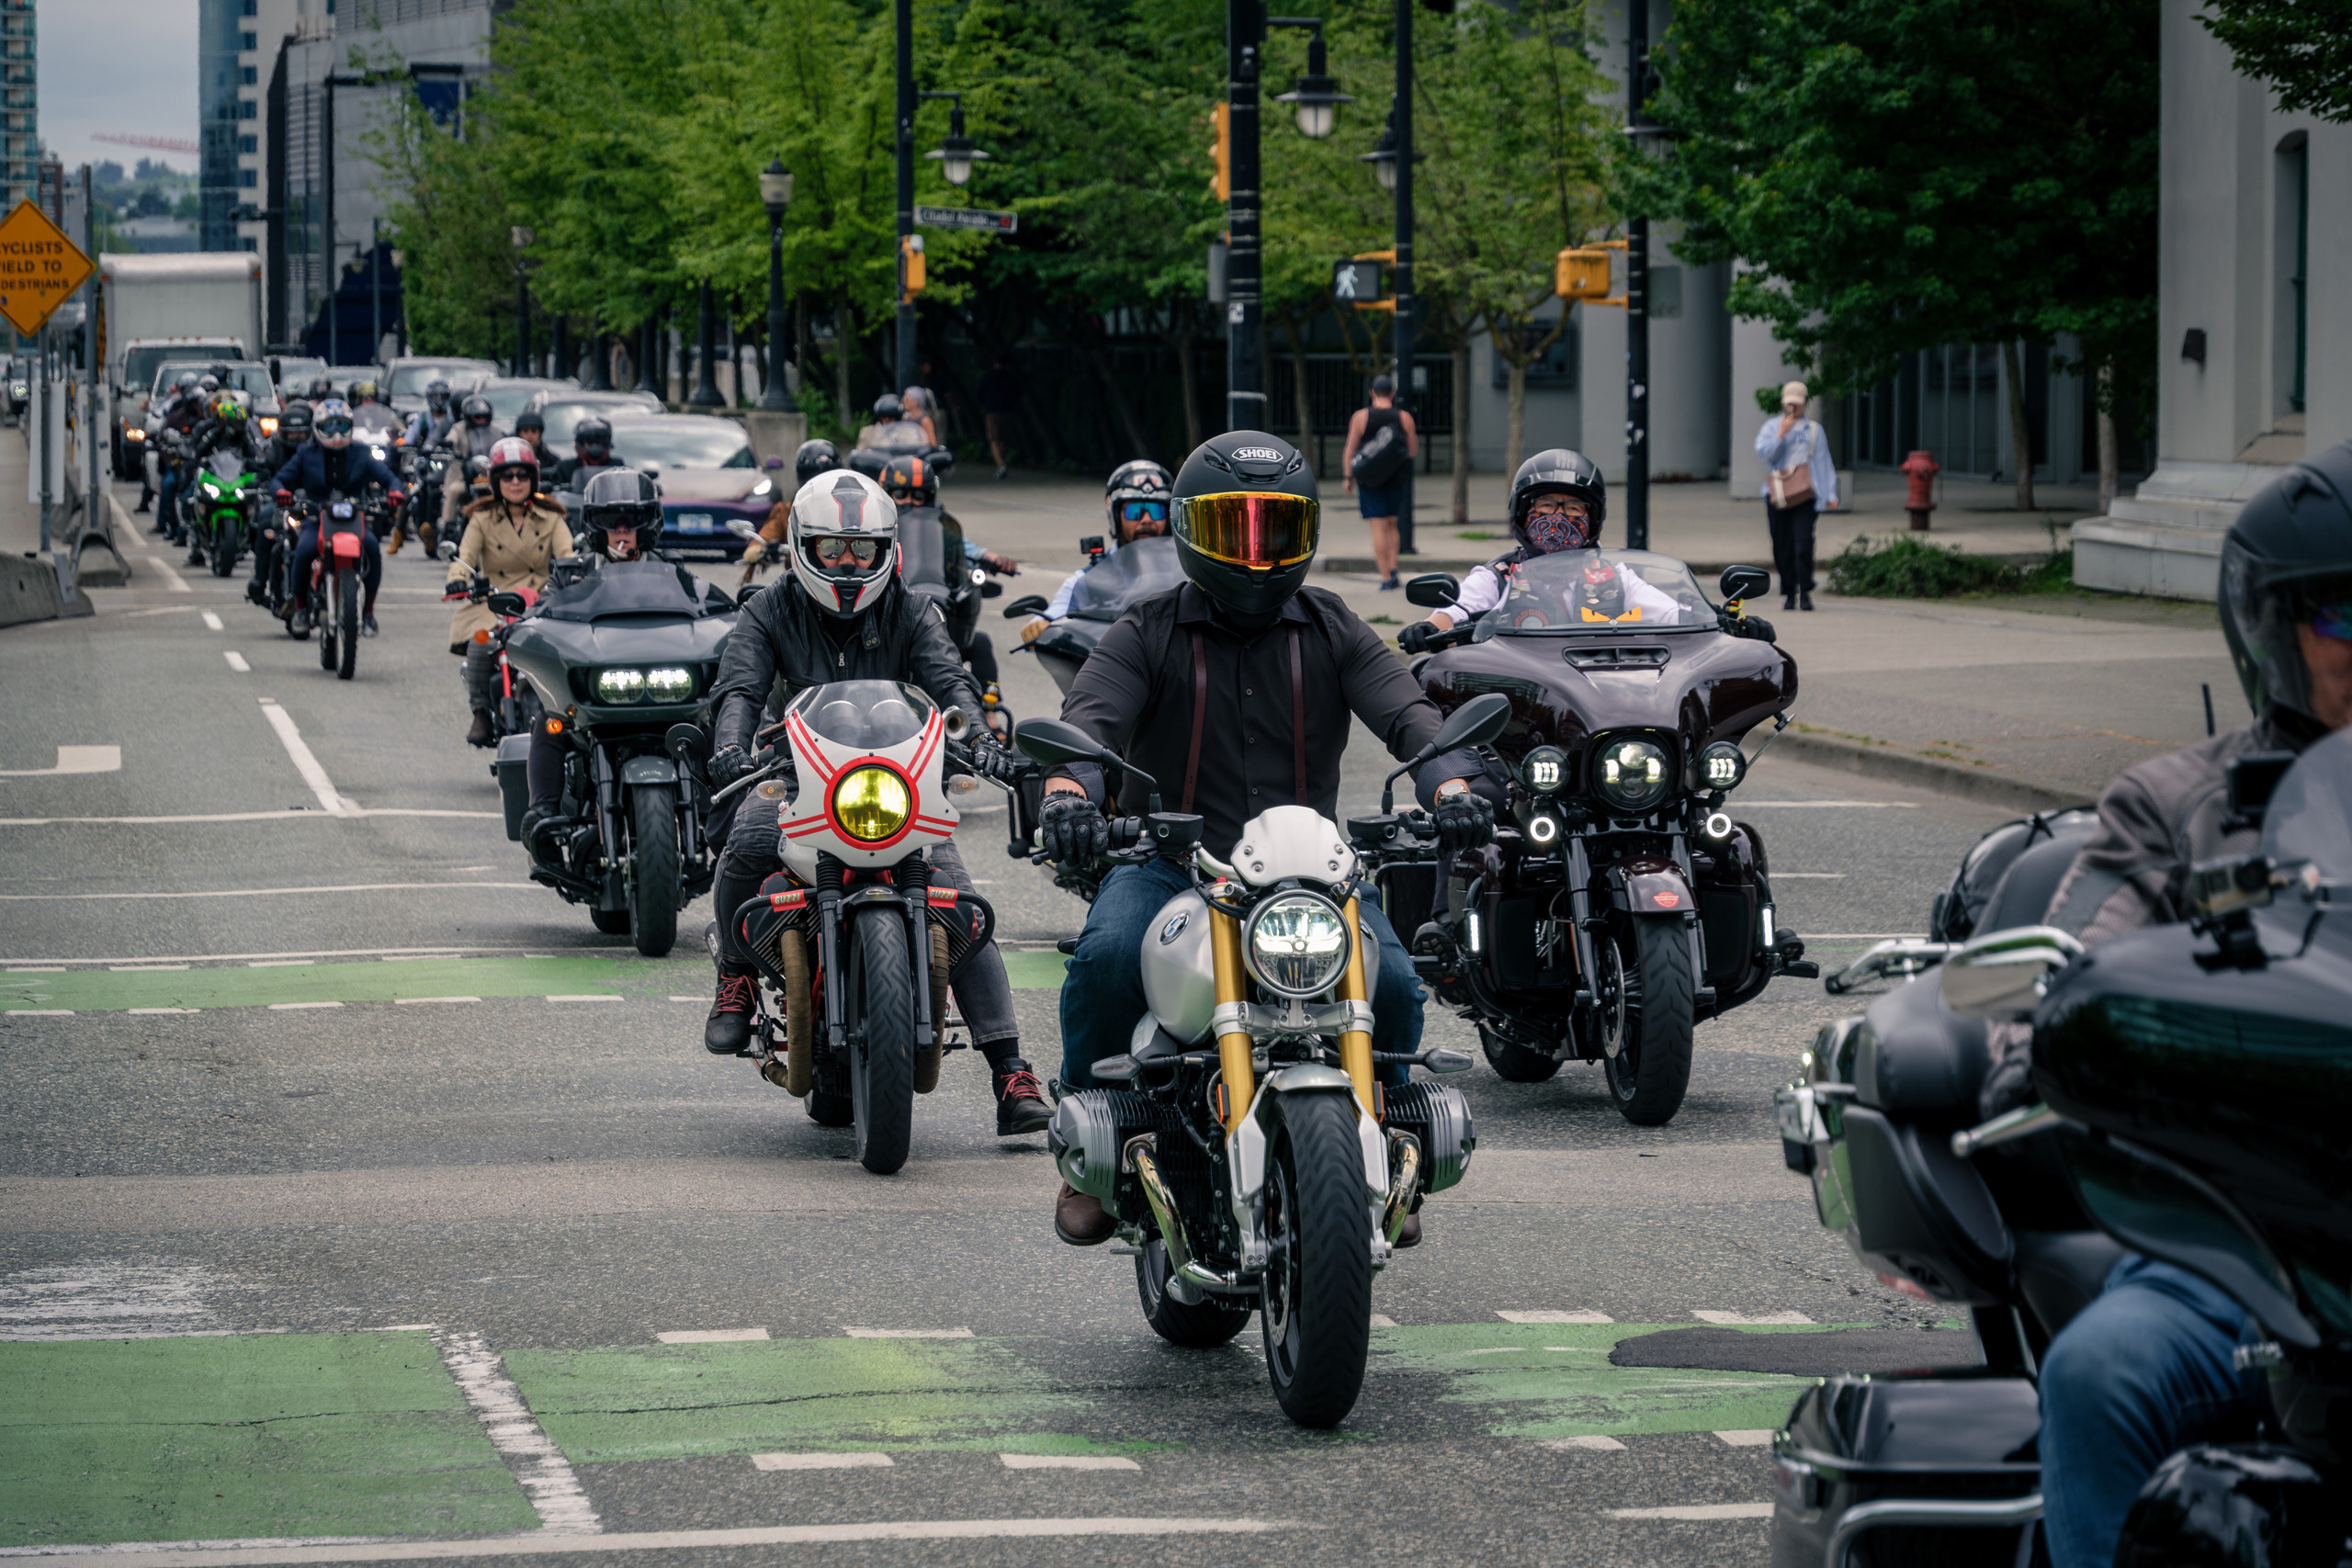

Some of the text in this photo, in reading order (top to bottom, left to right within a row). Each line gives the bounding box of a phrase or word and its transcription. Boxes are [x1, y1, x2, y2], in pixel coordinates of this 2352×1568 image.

[0, 241, 63, 255] YCLISTS
[0, 259, 62, 274] IELD TO
[0, 277, 70, 290] DESTRIANS
[1238, 449, 1277, 459] SHOEI
[775, 892, 801, 905] GUZZI
[929, 888, 955, 900] GUZZI
